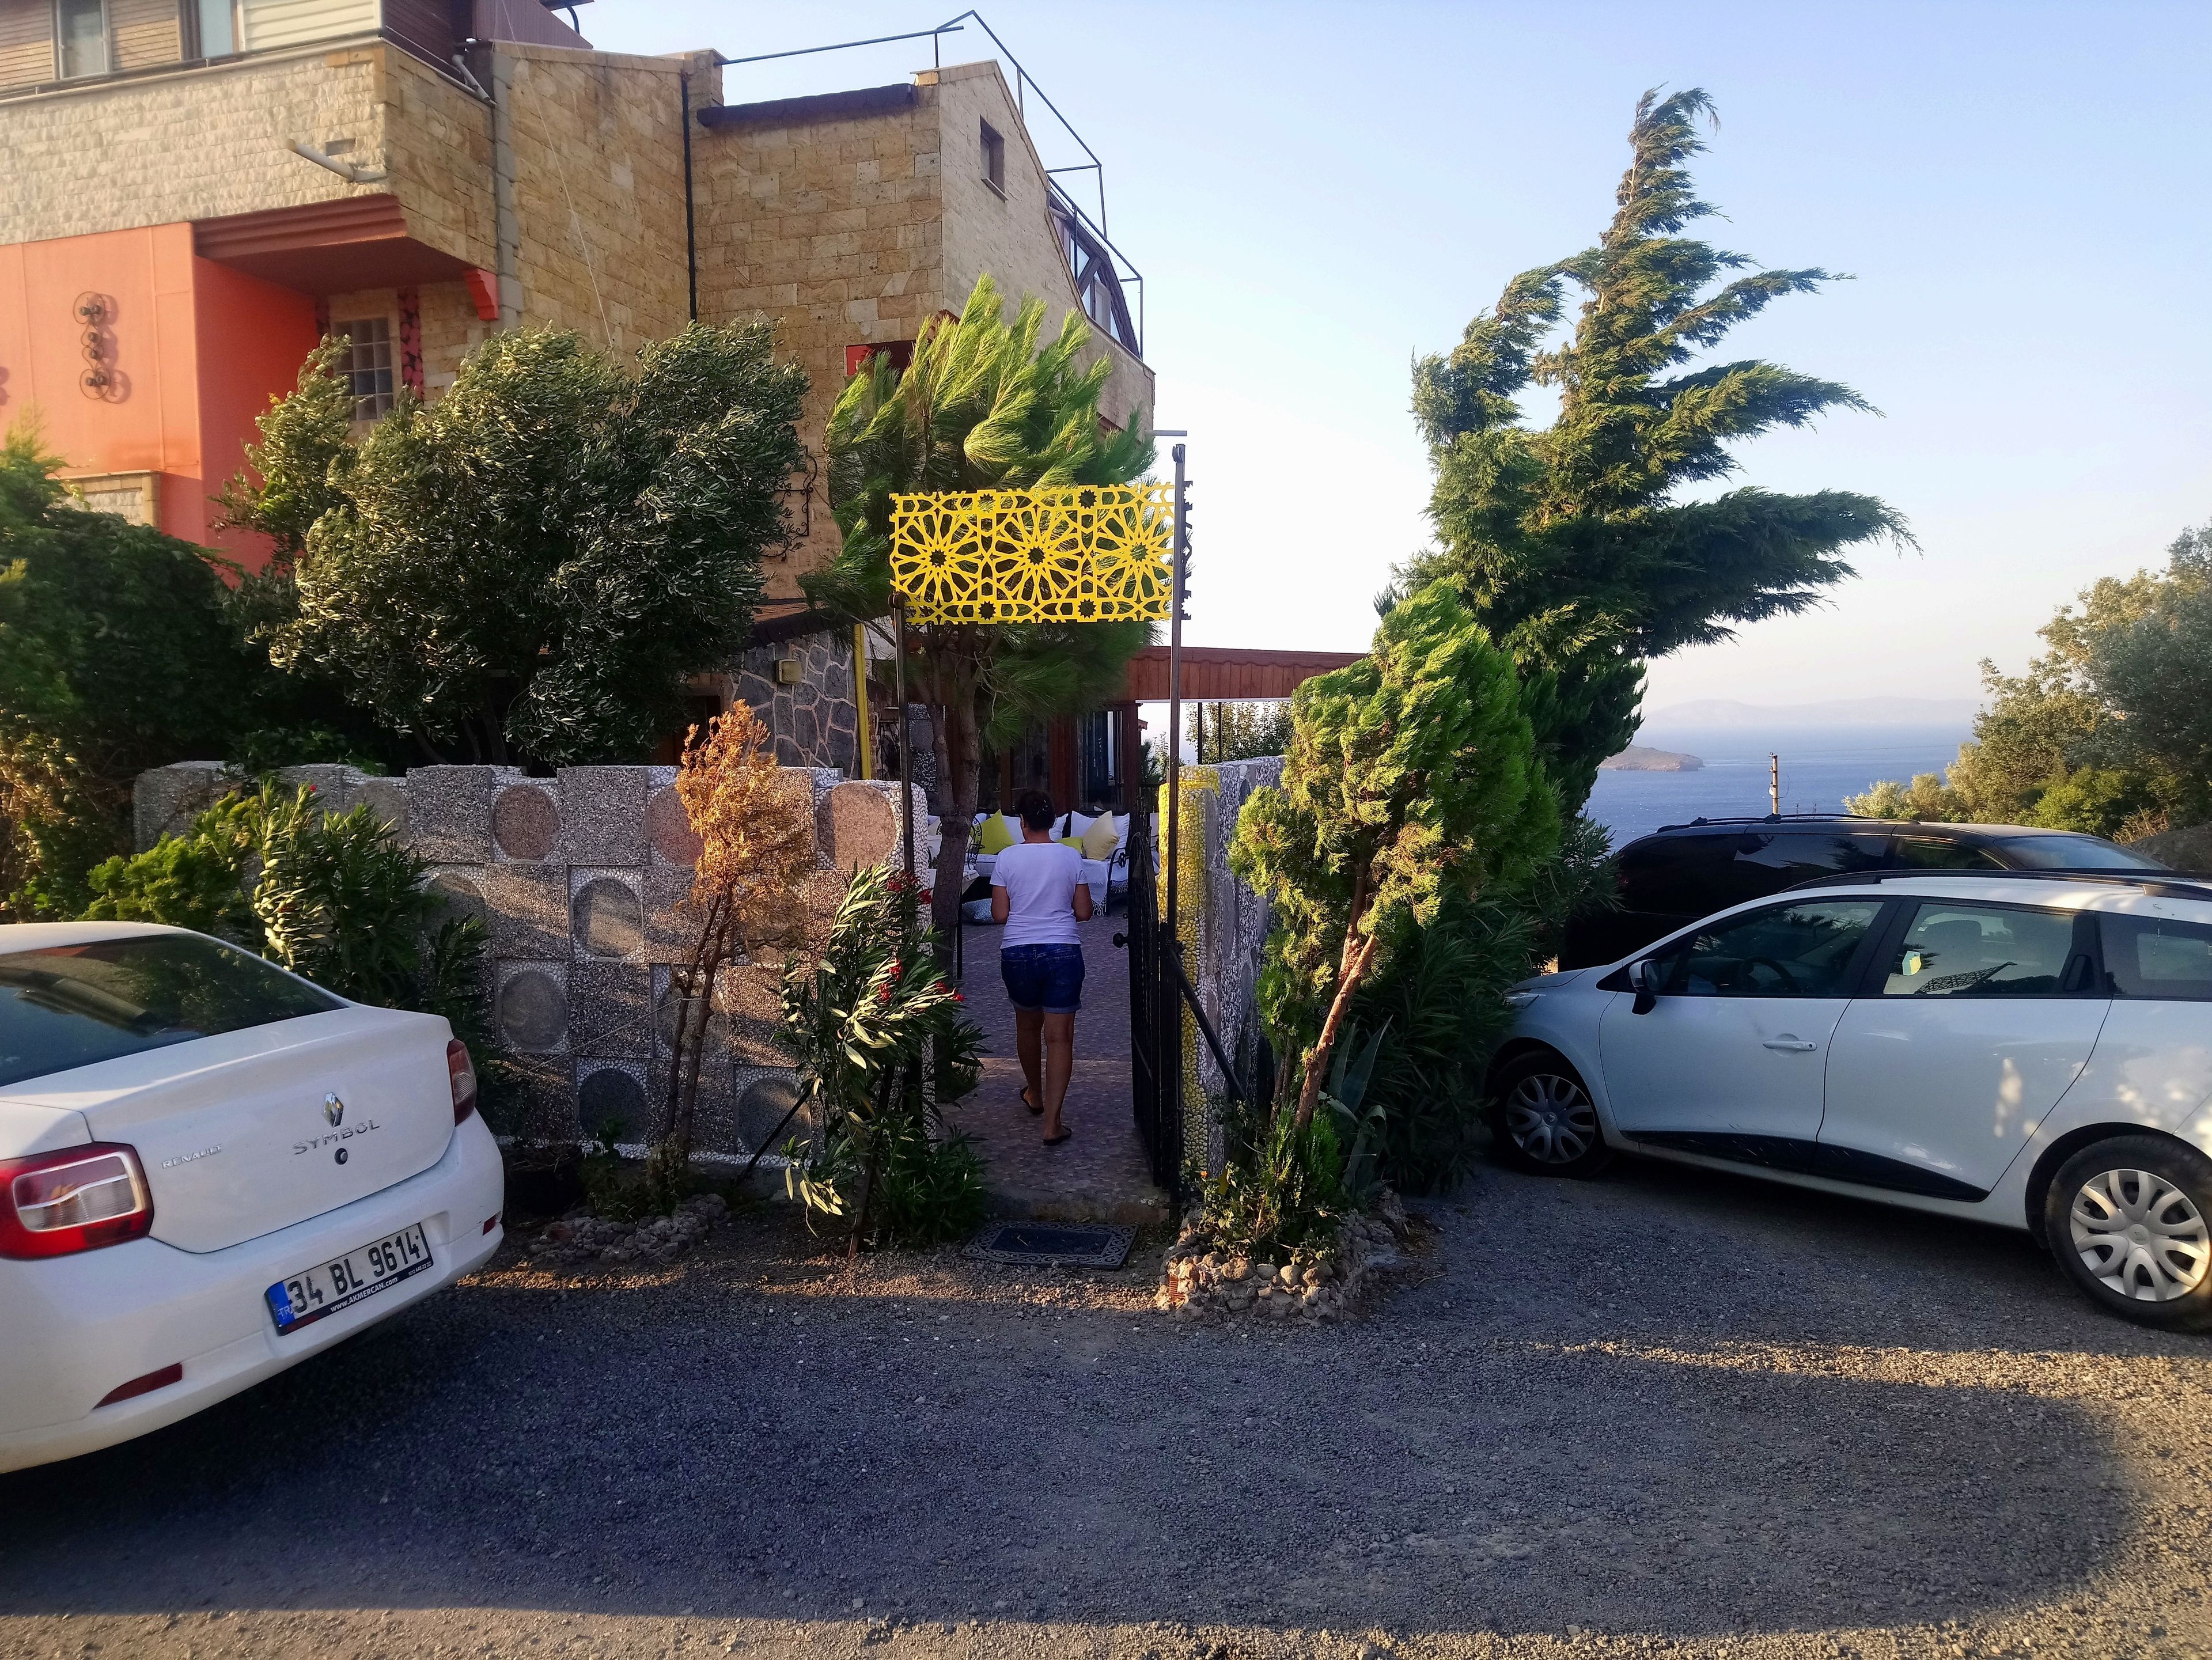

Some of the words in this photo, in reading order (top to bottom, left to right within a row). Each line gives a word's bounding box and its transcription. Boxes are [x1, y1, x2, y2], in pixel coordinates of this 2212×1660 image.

[292, 1119, 380, 1155] SYMBOL
[161, 1144, 222, 1169] RENAULT
[287, 1276, 323, 1313] 34
[328, 1259, 363, 1297] BL
[368, 1232, 420, 1278] 9614
[330, 1277, 398, 1313] www.AKMERCAN.com
